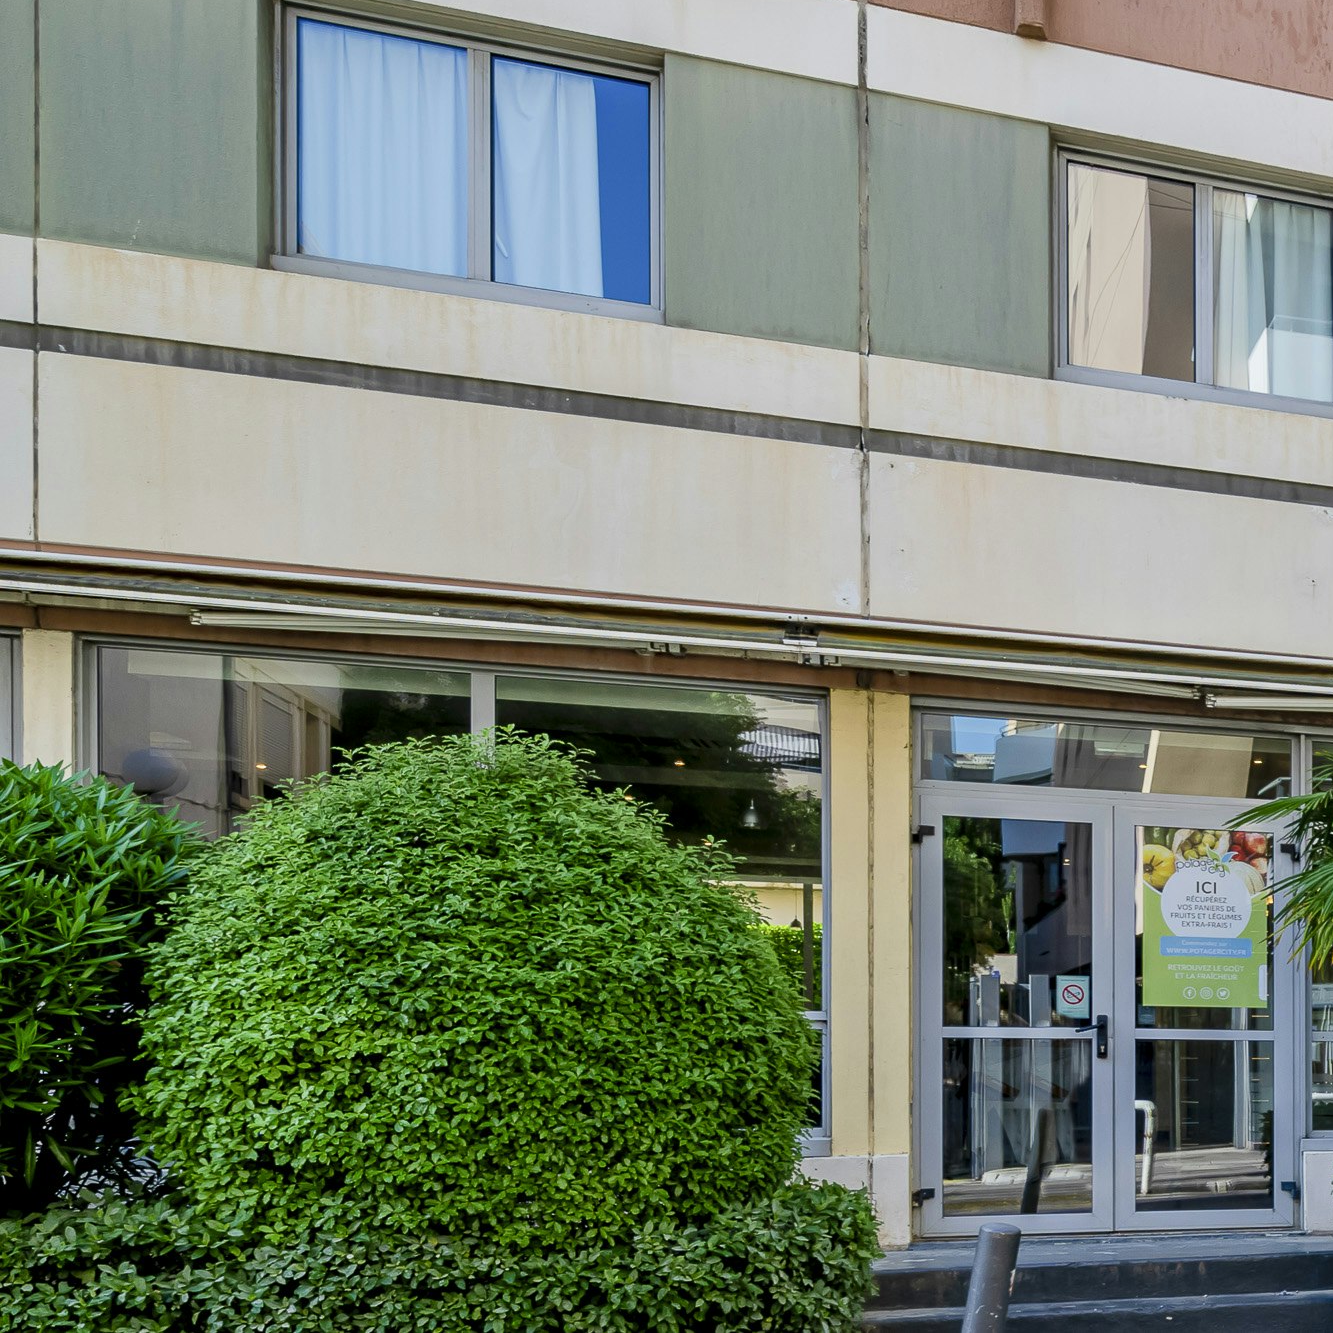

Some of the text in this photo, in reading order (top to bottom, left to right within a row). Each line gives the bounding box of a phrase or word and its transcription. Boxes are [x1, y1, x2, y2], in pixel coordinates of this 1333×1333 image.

[1196, 881, 1217, 894] ICI
[1186, 895, 1227, 904] RÉCUPÉREZ
[1194, 904, 1225, 912] PANIERS
[1170, 912, 1196, 920] FRUITS
[1208, 912, 1242, 921] LÉGUMES
[1181, 921, 1228, 929] EXTRA-FRAIS
[1168, 964, 1211, 972] RETROUVEZ
